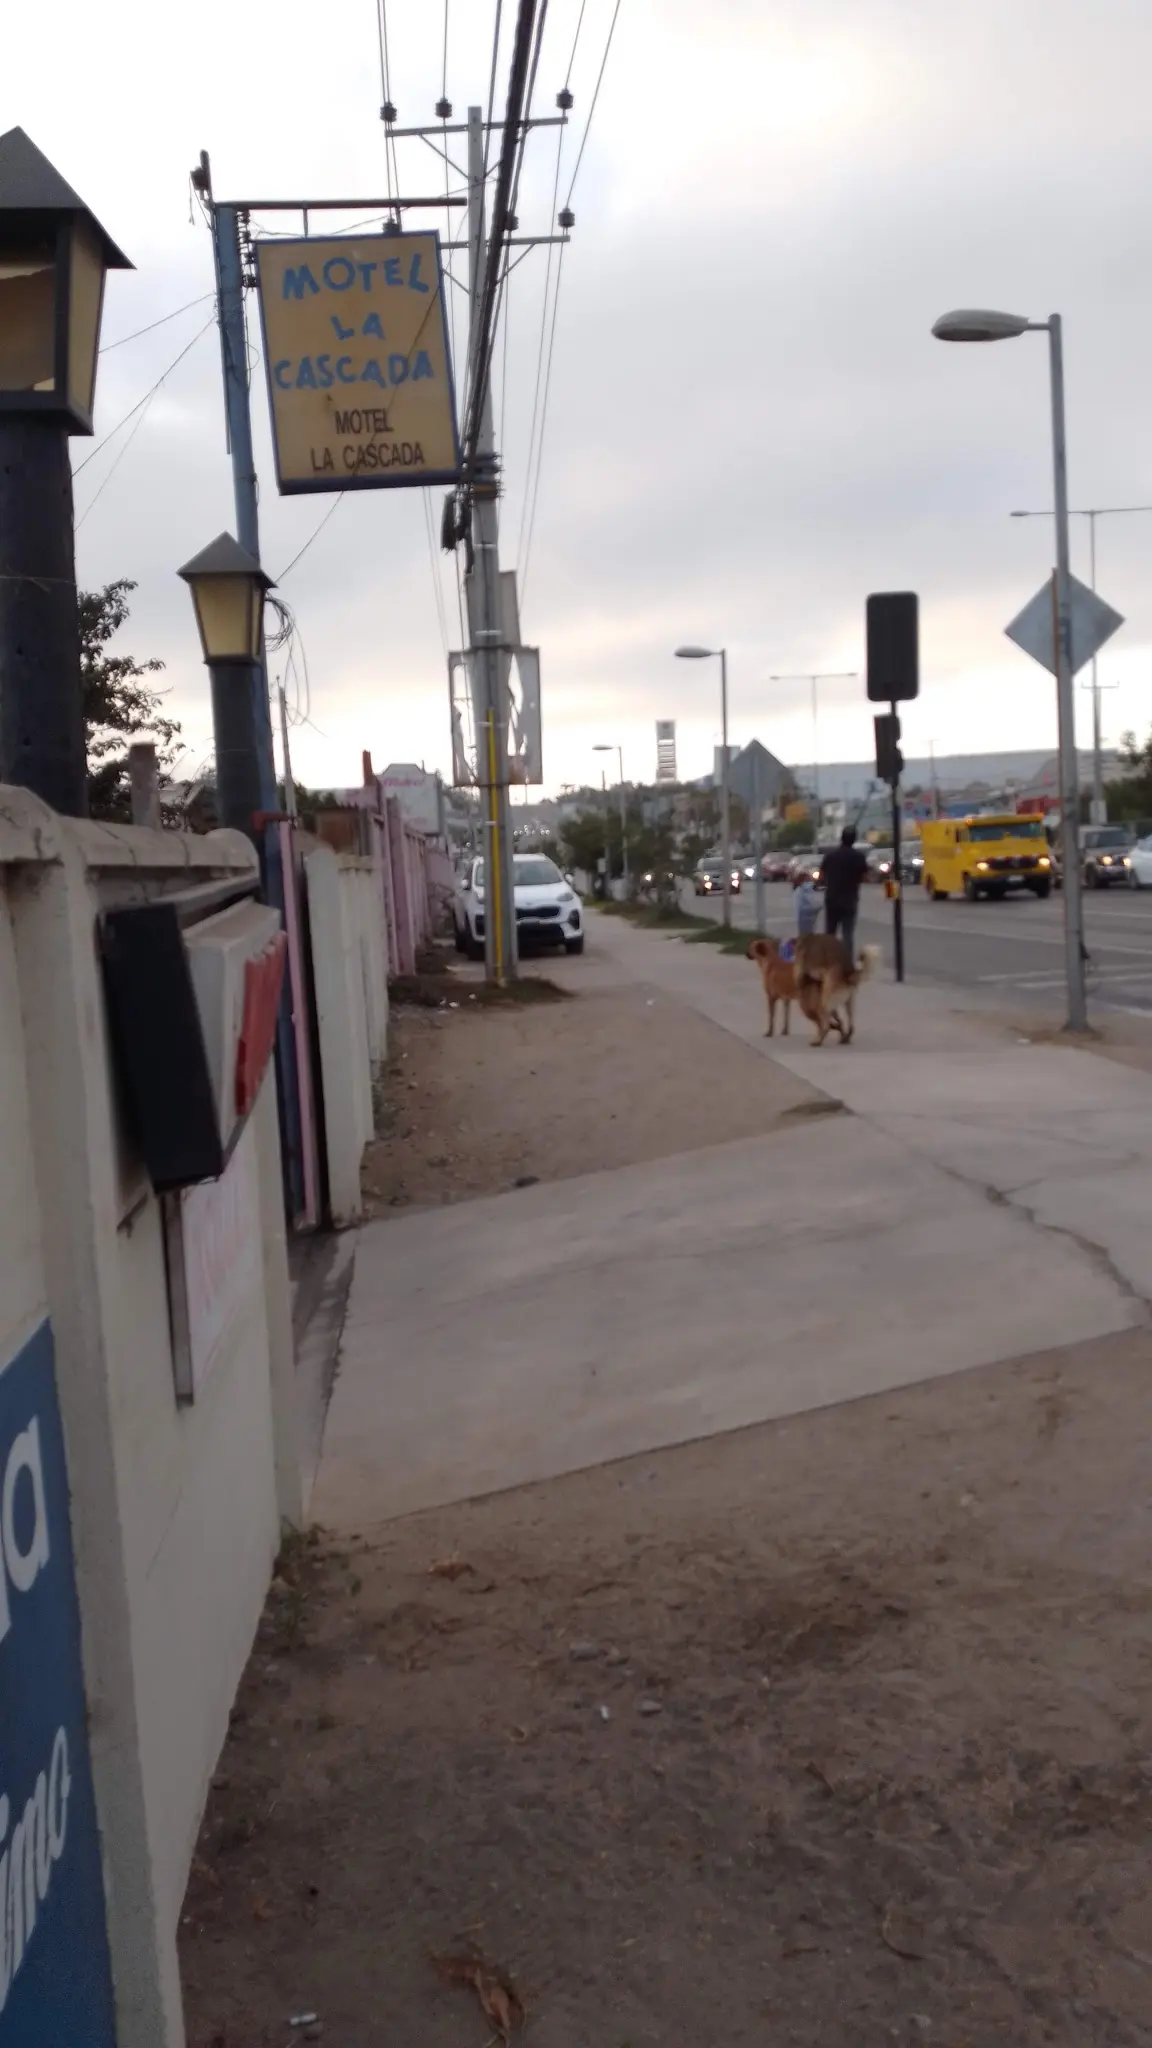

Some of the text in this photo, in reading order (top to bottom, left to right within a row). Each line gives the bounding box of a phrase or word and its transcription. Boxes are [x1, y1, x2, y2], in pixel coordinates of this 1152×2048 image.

[283, 253, 429, 299] MOTEL
[331, 312, 386, 340] LA
[274, 350, 434, 389] CASCADA
[335, 408, 394, 434] MOTEL
[310, 442, 425, 472] LA CASCADA
[0, 1415, 50, 1643] a
